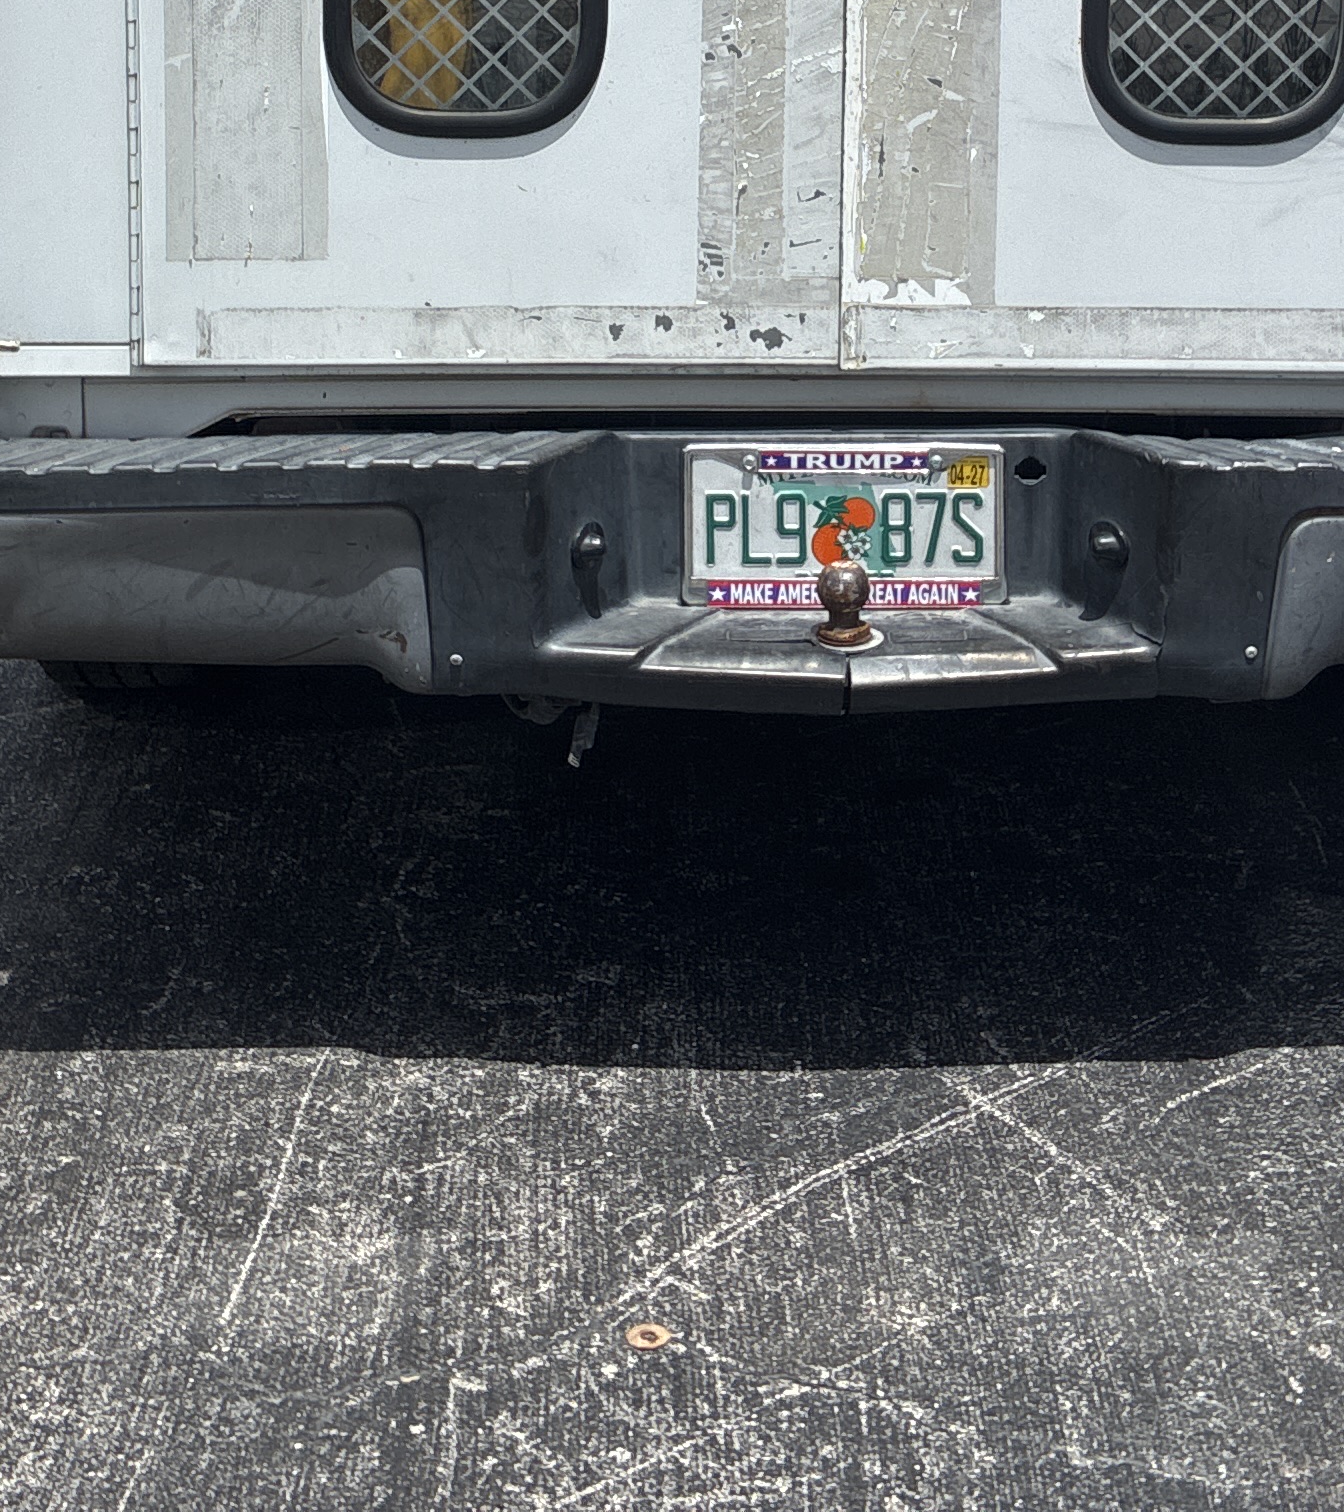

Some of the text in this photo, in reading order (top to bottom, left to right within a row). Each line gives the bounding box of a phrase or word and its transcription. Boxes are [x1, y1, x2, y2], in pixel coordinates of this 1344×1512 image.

[783, 453, 905, 469] TRUMP
[950, 464, 986, 486] 04-27
[706, 492, 984, 566] PL9 87S
[730, 583, 959, 604] MAKE AMER REAT AGAIN
